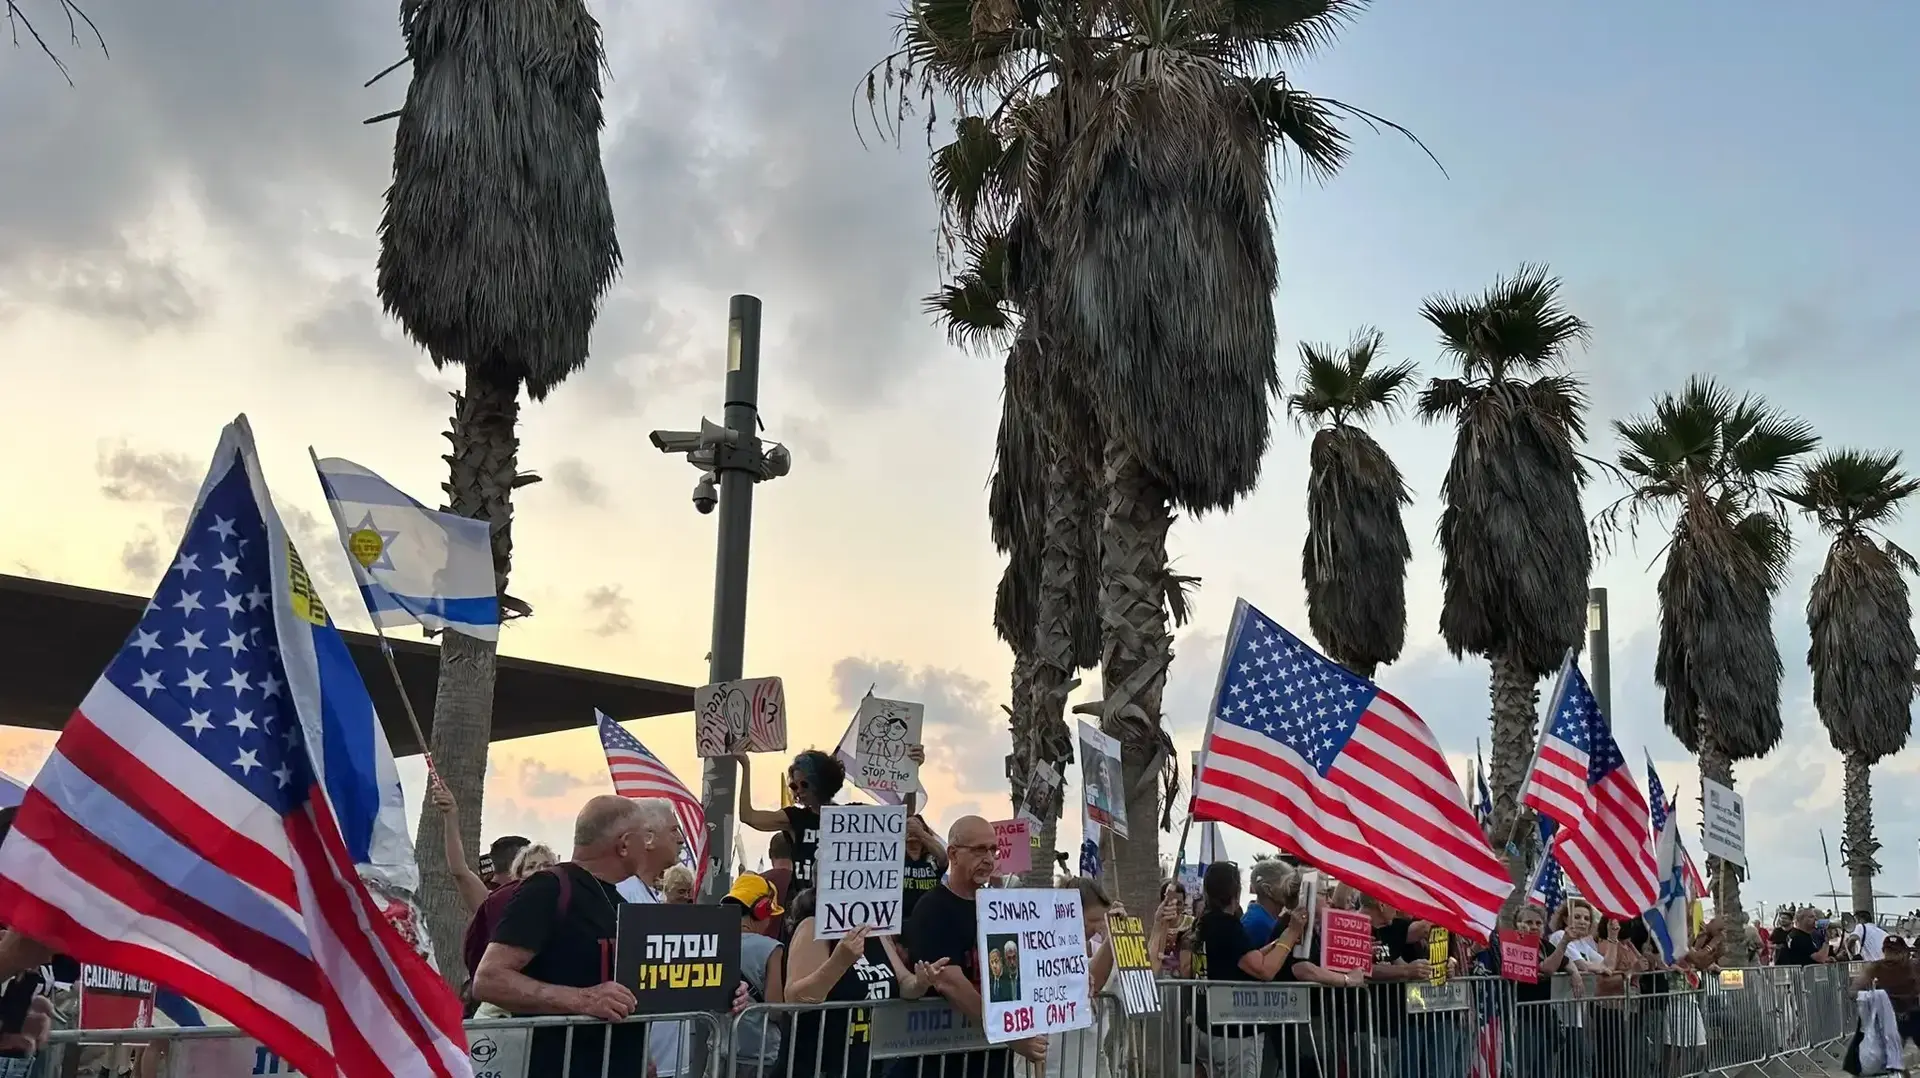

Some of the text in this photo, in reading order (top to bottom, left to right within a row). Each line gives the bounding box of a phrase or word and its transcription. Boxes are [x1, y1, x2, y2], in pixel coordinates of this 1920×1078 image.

[862, 765, 885, 778] STOP
[829, 813, 902, 834] BRING
[994, 823, 1025, 836] TAGE
[831, 841, 898, 862] THEM
[998, 837, 1012, 848] AL
[829, 869, 899, 890] HOME
[915, 879, 937, 890] TRUST
[824, 900, 899, 930] NOW
[988, 901, 1076, 921] SINWAR HAVE
[1334, 917, 1363, 930] עסקה!
[646, 934, 719, 963] עסקה
[1023, 929, 1080, 950] MERCY ON OUR
[1333, 935, 1362, 948] עסקה!
[1114, 935, 1151, 968] HOME
[1332, 953, 1361, 966] עסקה!
[84, 964, 123, 990] CALLING
[640, 963, 723, 990] עכשיו!
[1036, 955, 1085, 978] HOSTAGES
[1033, 985, 1068, 1003] BECAUSE
[1120, 969, 1161, 1014] NOW!
[1003, 1006, 1035, 1033] BIBI
[1046, 1001, 1077, 1026] CAN'T
